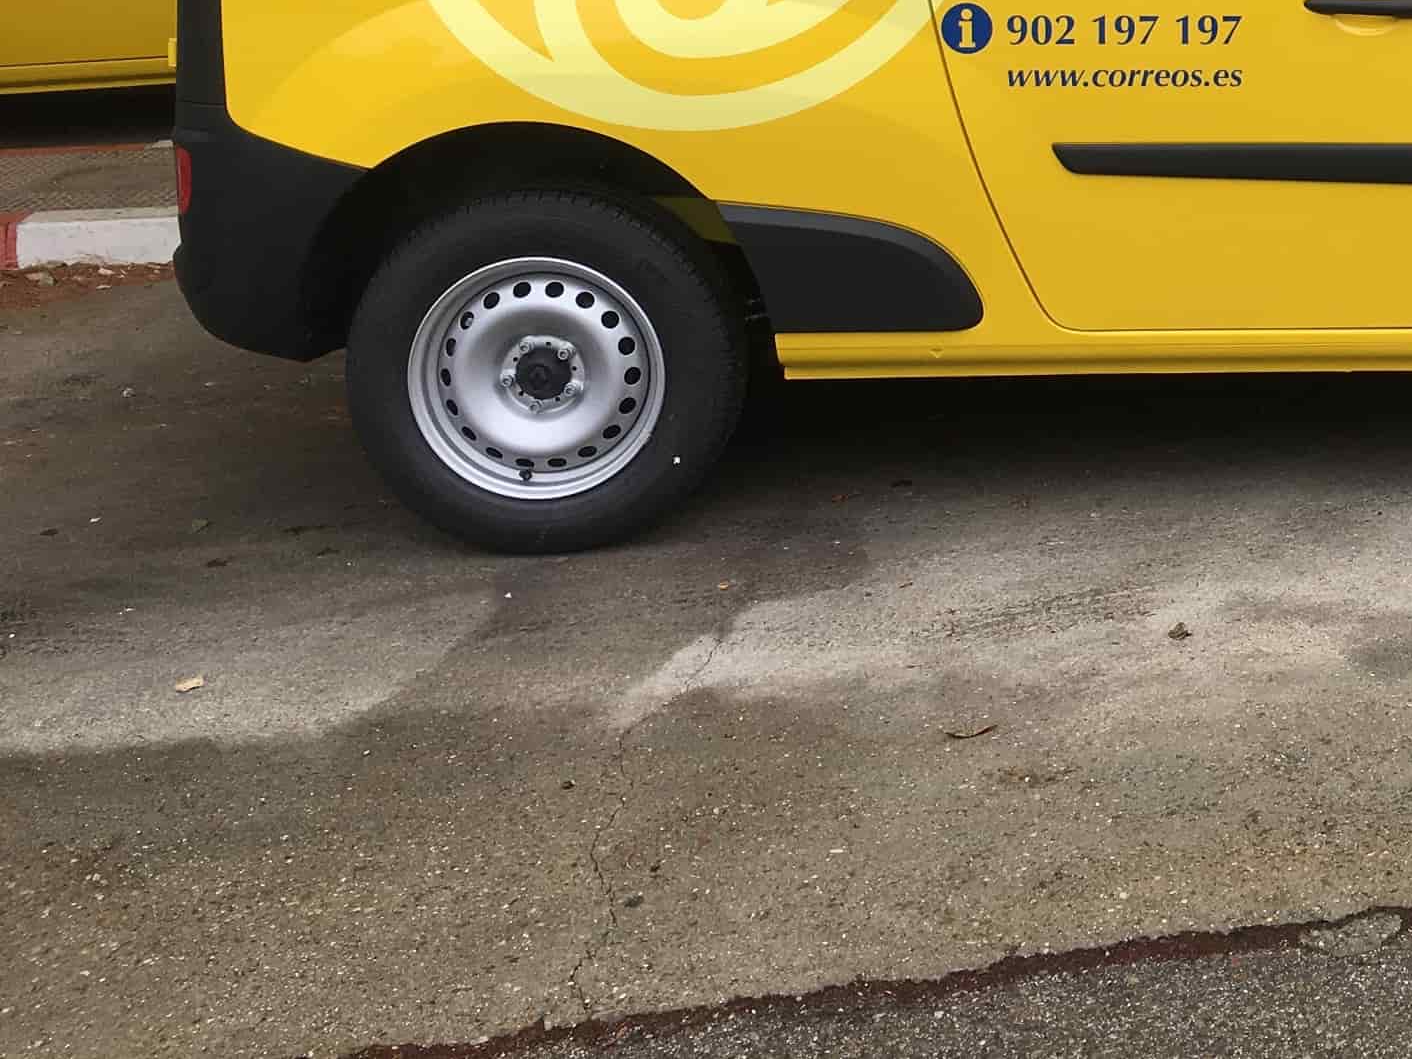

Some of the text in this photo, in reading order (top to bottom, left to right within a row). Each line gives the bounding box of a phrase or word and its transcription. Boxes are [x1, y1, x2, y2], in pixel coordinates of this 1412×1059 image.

[1006, 14, 1076, 46] 902
[1091, 14, 1160, 46] 197
[1174, 15, 1243, 46] 197
[1006, 67, 1243, 88] www.correos.es
